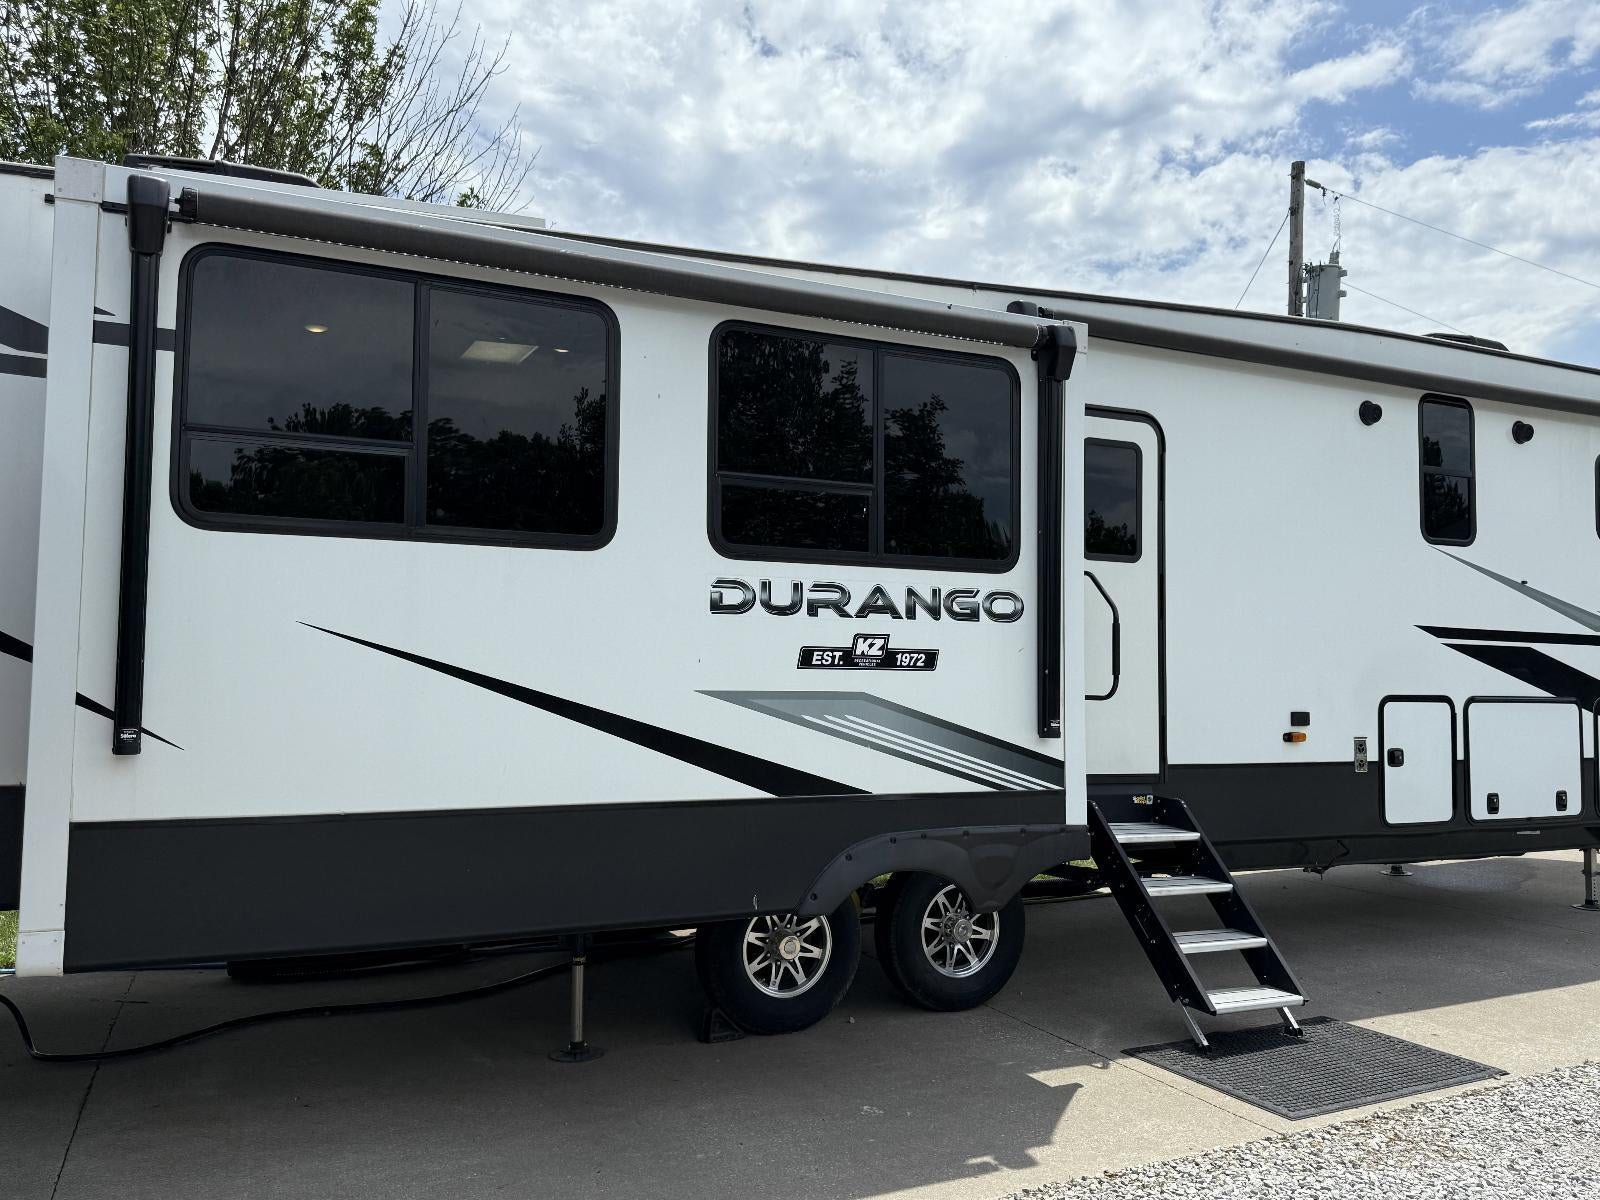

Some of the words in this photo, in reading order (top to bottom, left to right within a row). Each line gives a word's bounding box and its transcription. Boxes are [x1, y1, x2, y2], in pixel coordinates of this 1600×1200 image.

[709, 577, 1025, 624] DURANGO
[855, 637, 885, 656] KZ
[811, 651, 844, 665] EST.
[895, 653, 926, 667] 1972
